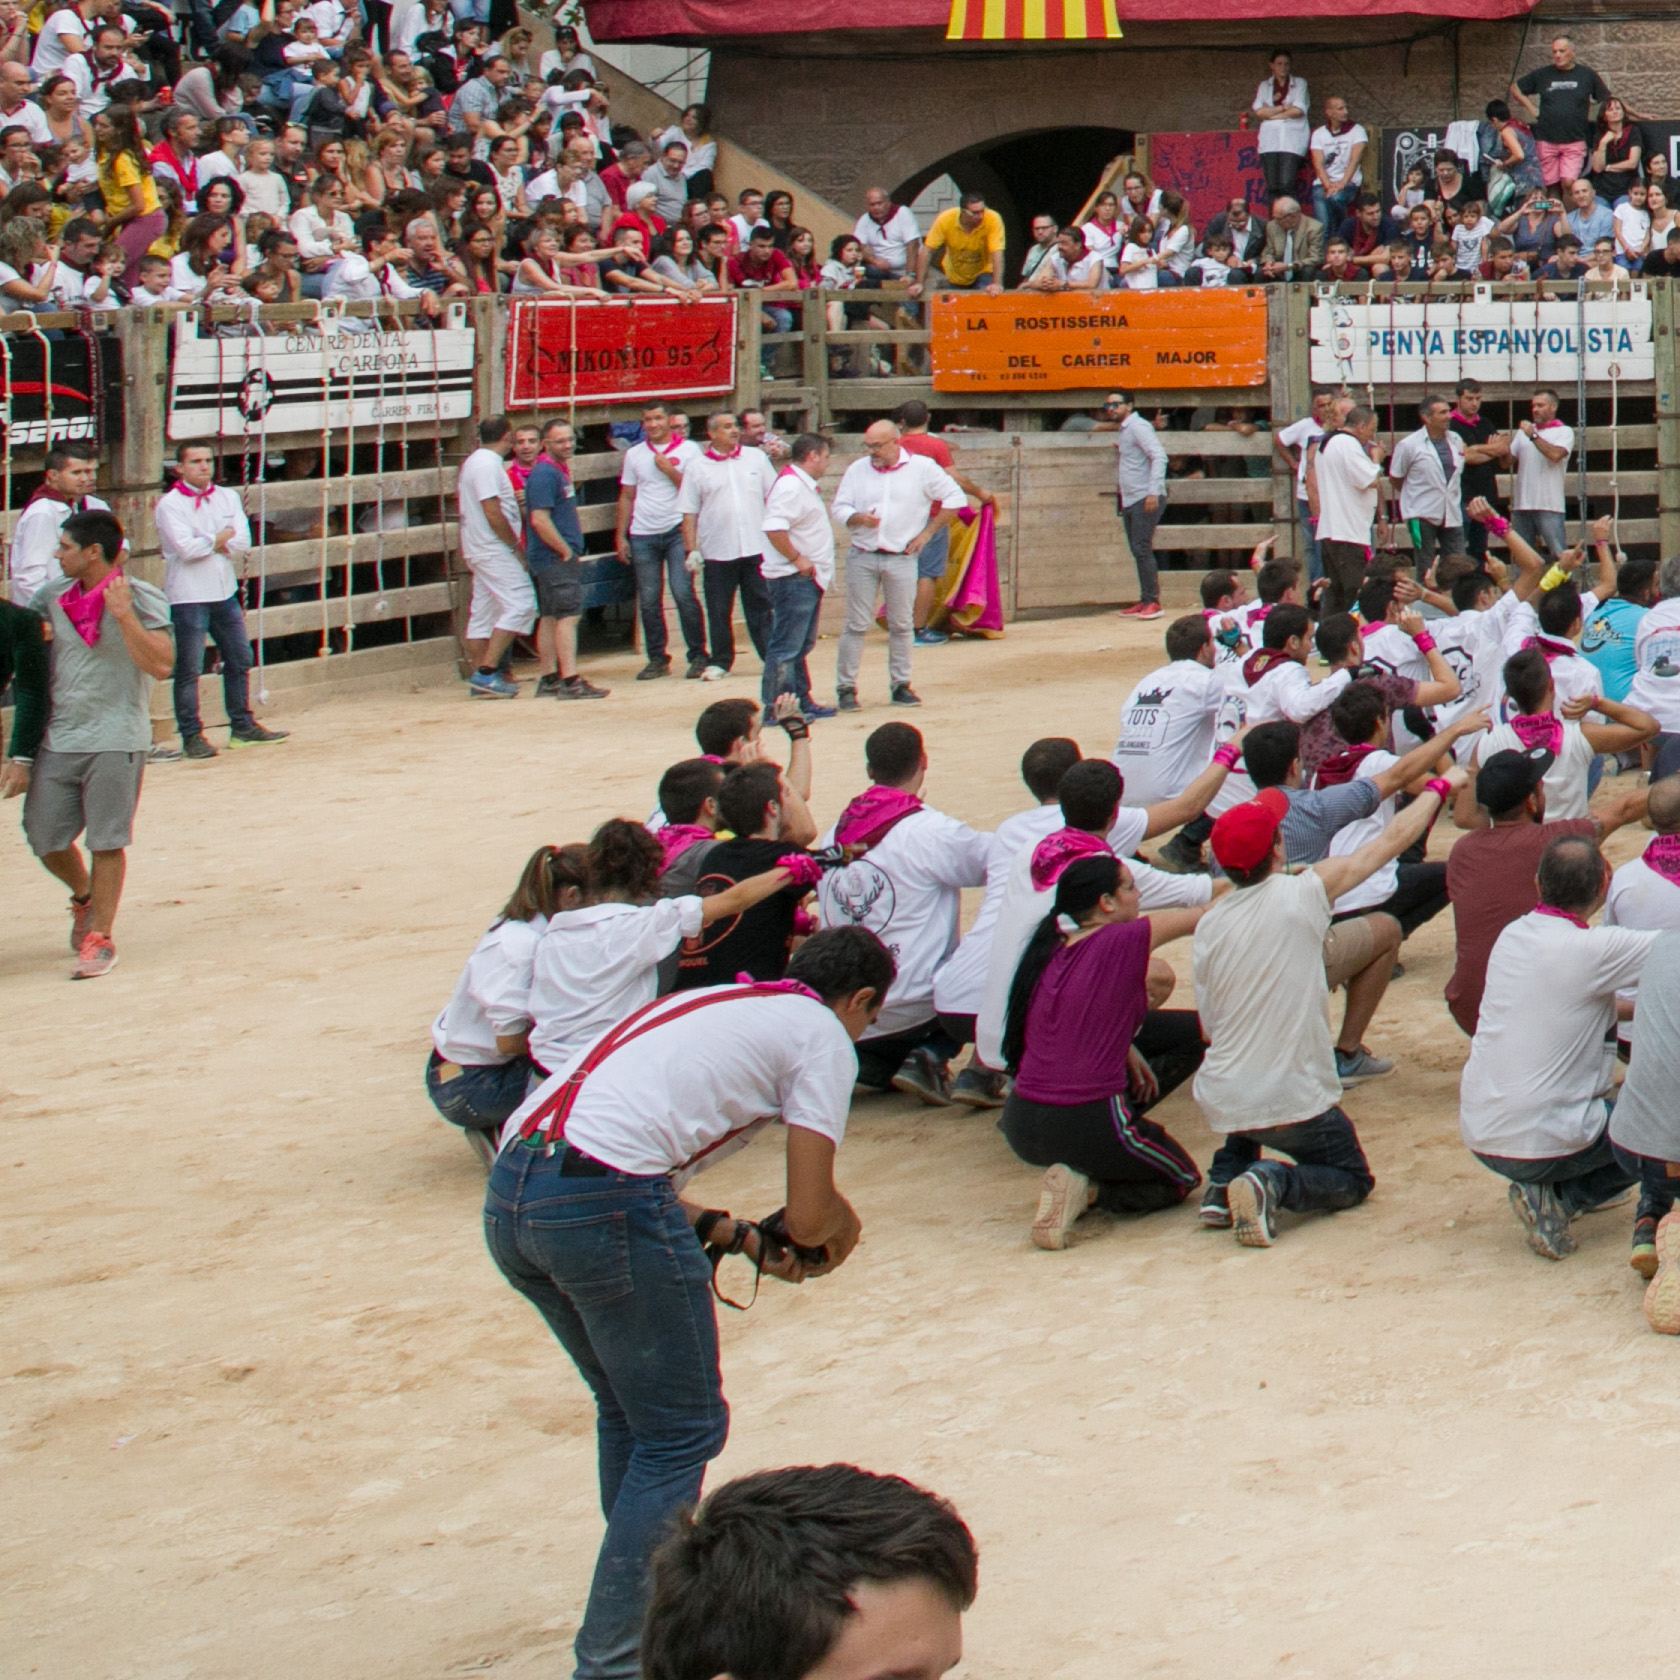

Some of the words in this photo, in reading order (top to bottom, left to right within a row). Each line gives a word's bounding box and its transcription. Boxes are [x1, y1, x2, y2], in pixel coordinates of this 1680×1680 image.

[967, 318, 988, 331] LA
[1014, 315, 1129, 330] ROSTISSERIA
[285, 333, 349, 354] CENTRE
[353, 331, 410, 351] DENTAL
[1367, 329, 1445, 356] PENYA
[1454, 327, 1633, 355] ESPANYOLSTA
[1008, 355, 1041, 368] DEL
[1061, 353, 1131, 367] CARRER
[1156, 351, 1216, 364] MAJOR
[372, 405, 412, 418] CARRER
[1127, 708, 1159, 726] TOTS
